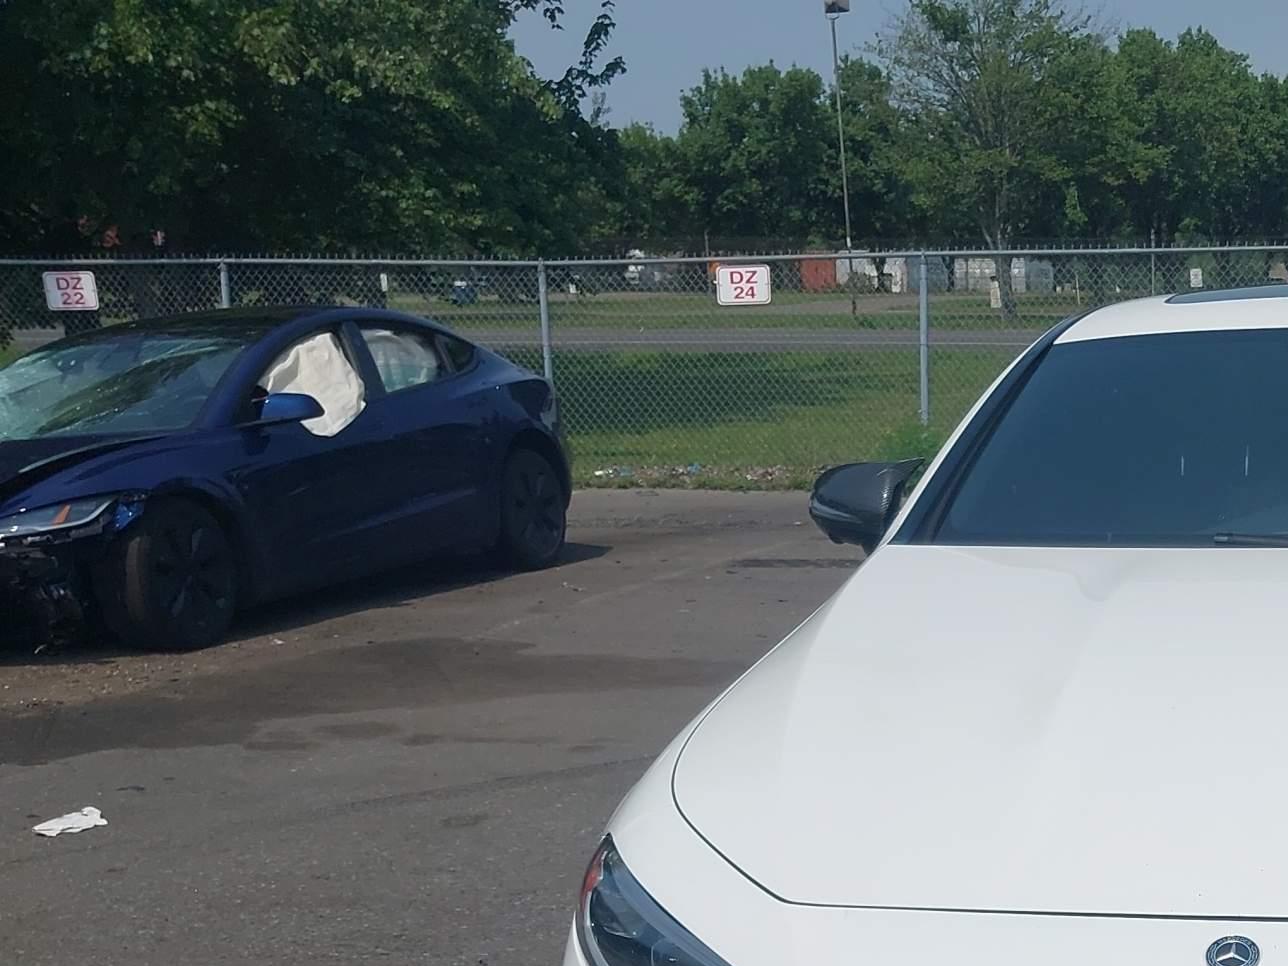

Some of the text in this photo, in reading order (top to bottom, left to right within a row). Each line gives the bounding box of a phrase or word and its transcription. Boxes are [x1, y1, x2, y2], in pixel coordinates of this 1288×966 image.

[55, 276, 85, 291] DZ
[729, 270, 758, 285] DZ
[60, 291, 86, 306] 22
[733, 286, 757, 300] 24
